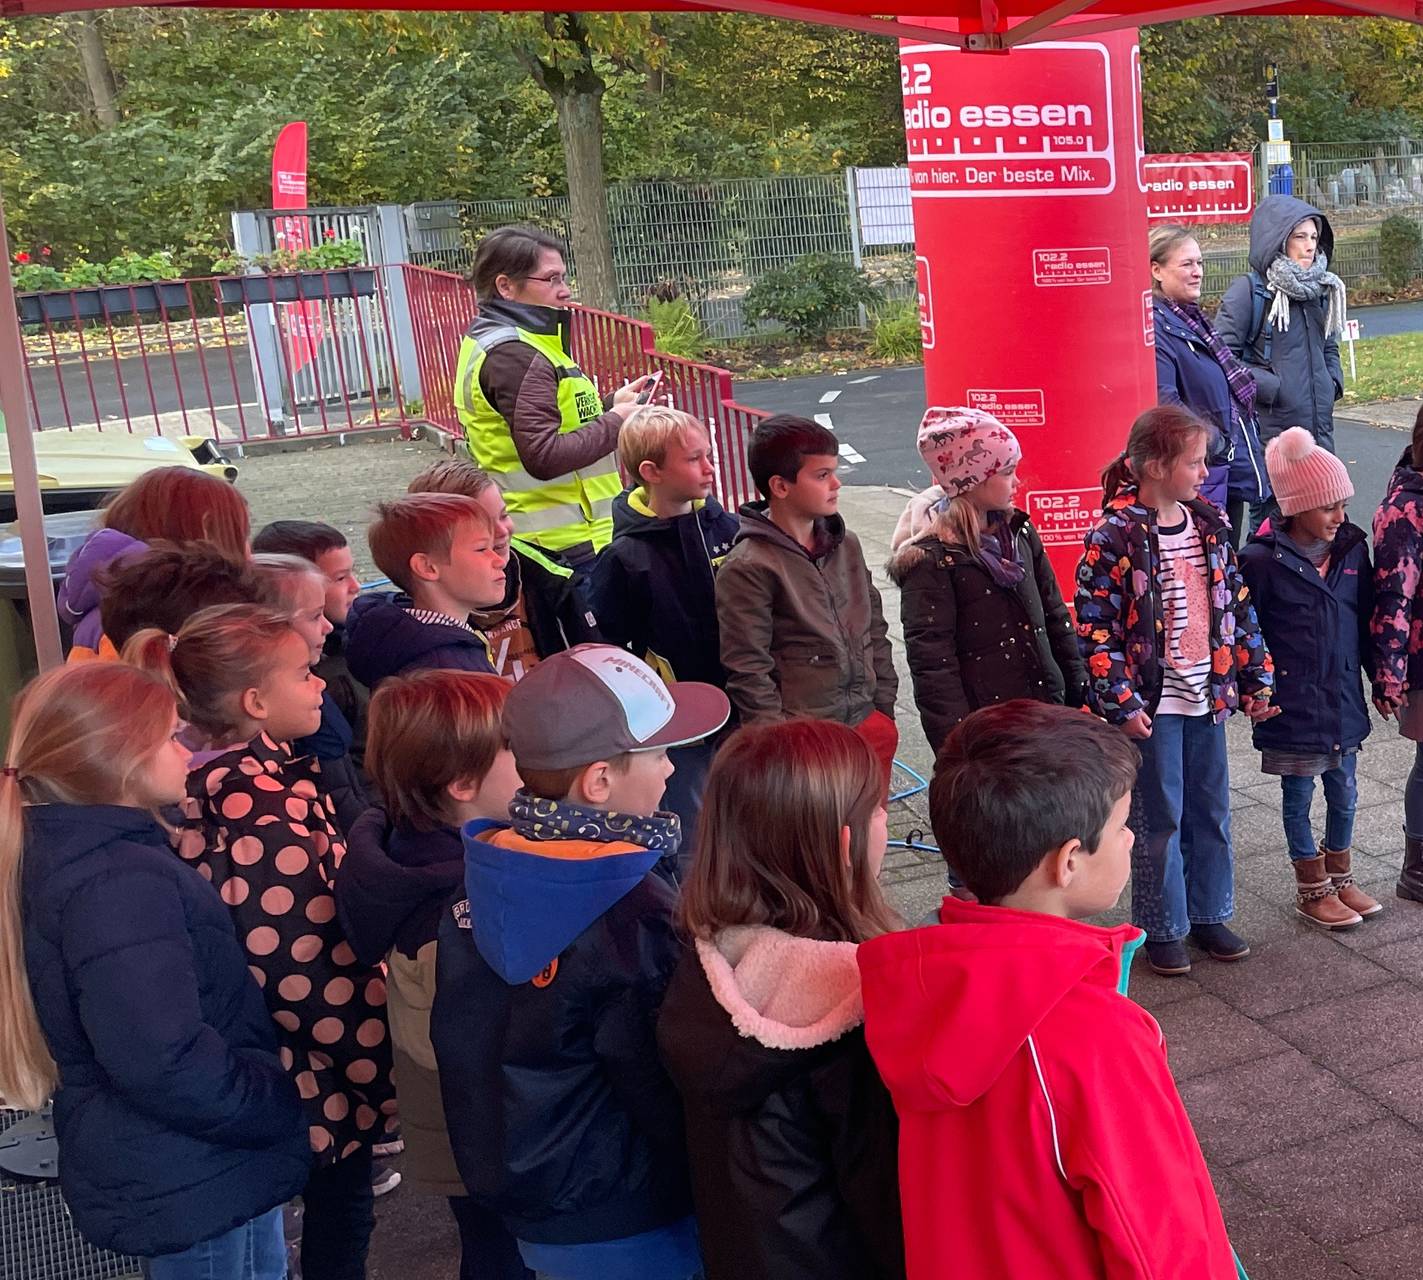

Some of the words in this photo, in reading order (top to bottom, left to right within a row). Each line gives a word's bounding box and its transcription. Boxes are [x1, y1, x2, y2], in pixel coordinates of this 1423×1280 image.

[959, 104, 1092, 127] essen
[1053, 135, 1084, 146] 105.0
[931, 167, 960, 184] hier.
[965, 167, 997, 184] Der
[1003, 166, 1054, 183] beste
[1061, 165, 1095, 182] Mix.
[1145, 179, 1184, 192] radio
[1188, 180, 1234, 190] essen
[1038, 253, 1068, 262] 102.2
[1044, 262, 1073, 270] radio
[1076, 261, 1106, 269] essen
[1034, 495, 1081, 509] 102.2
[1044, 508, 1090, 522] radio
